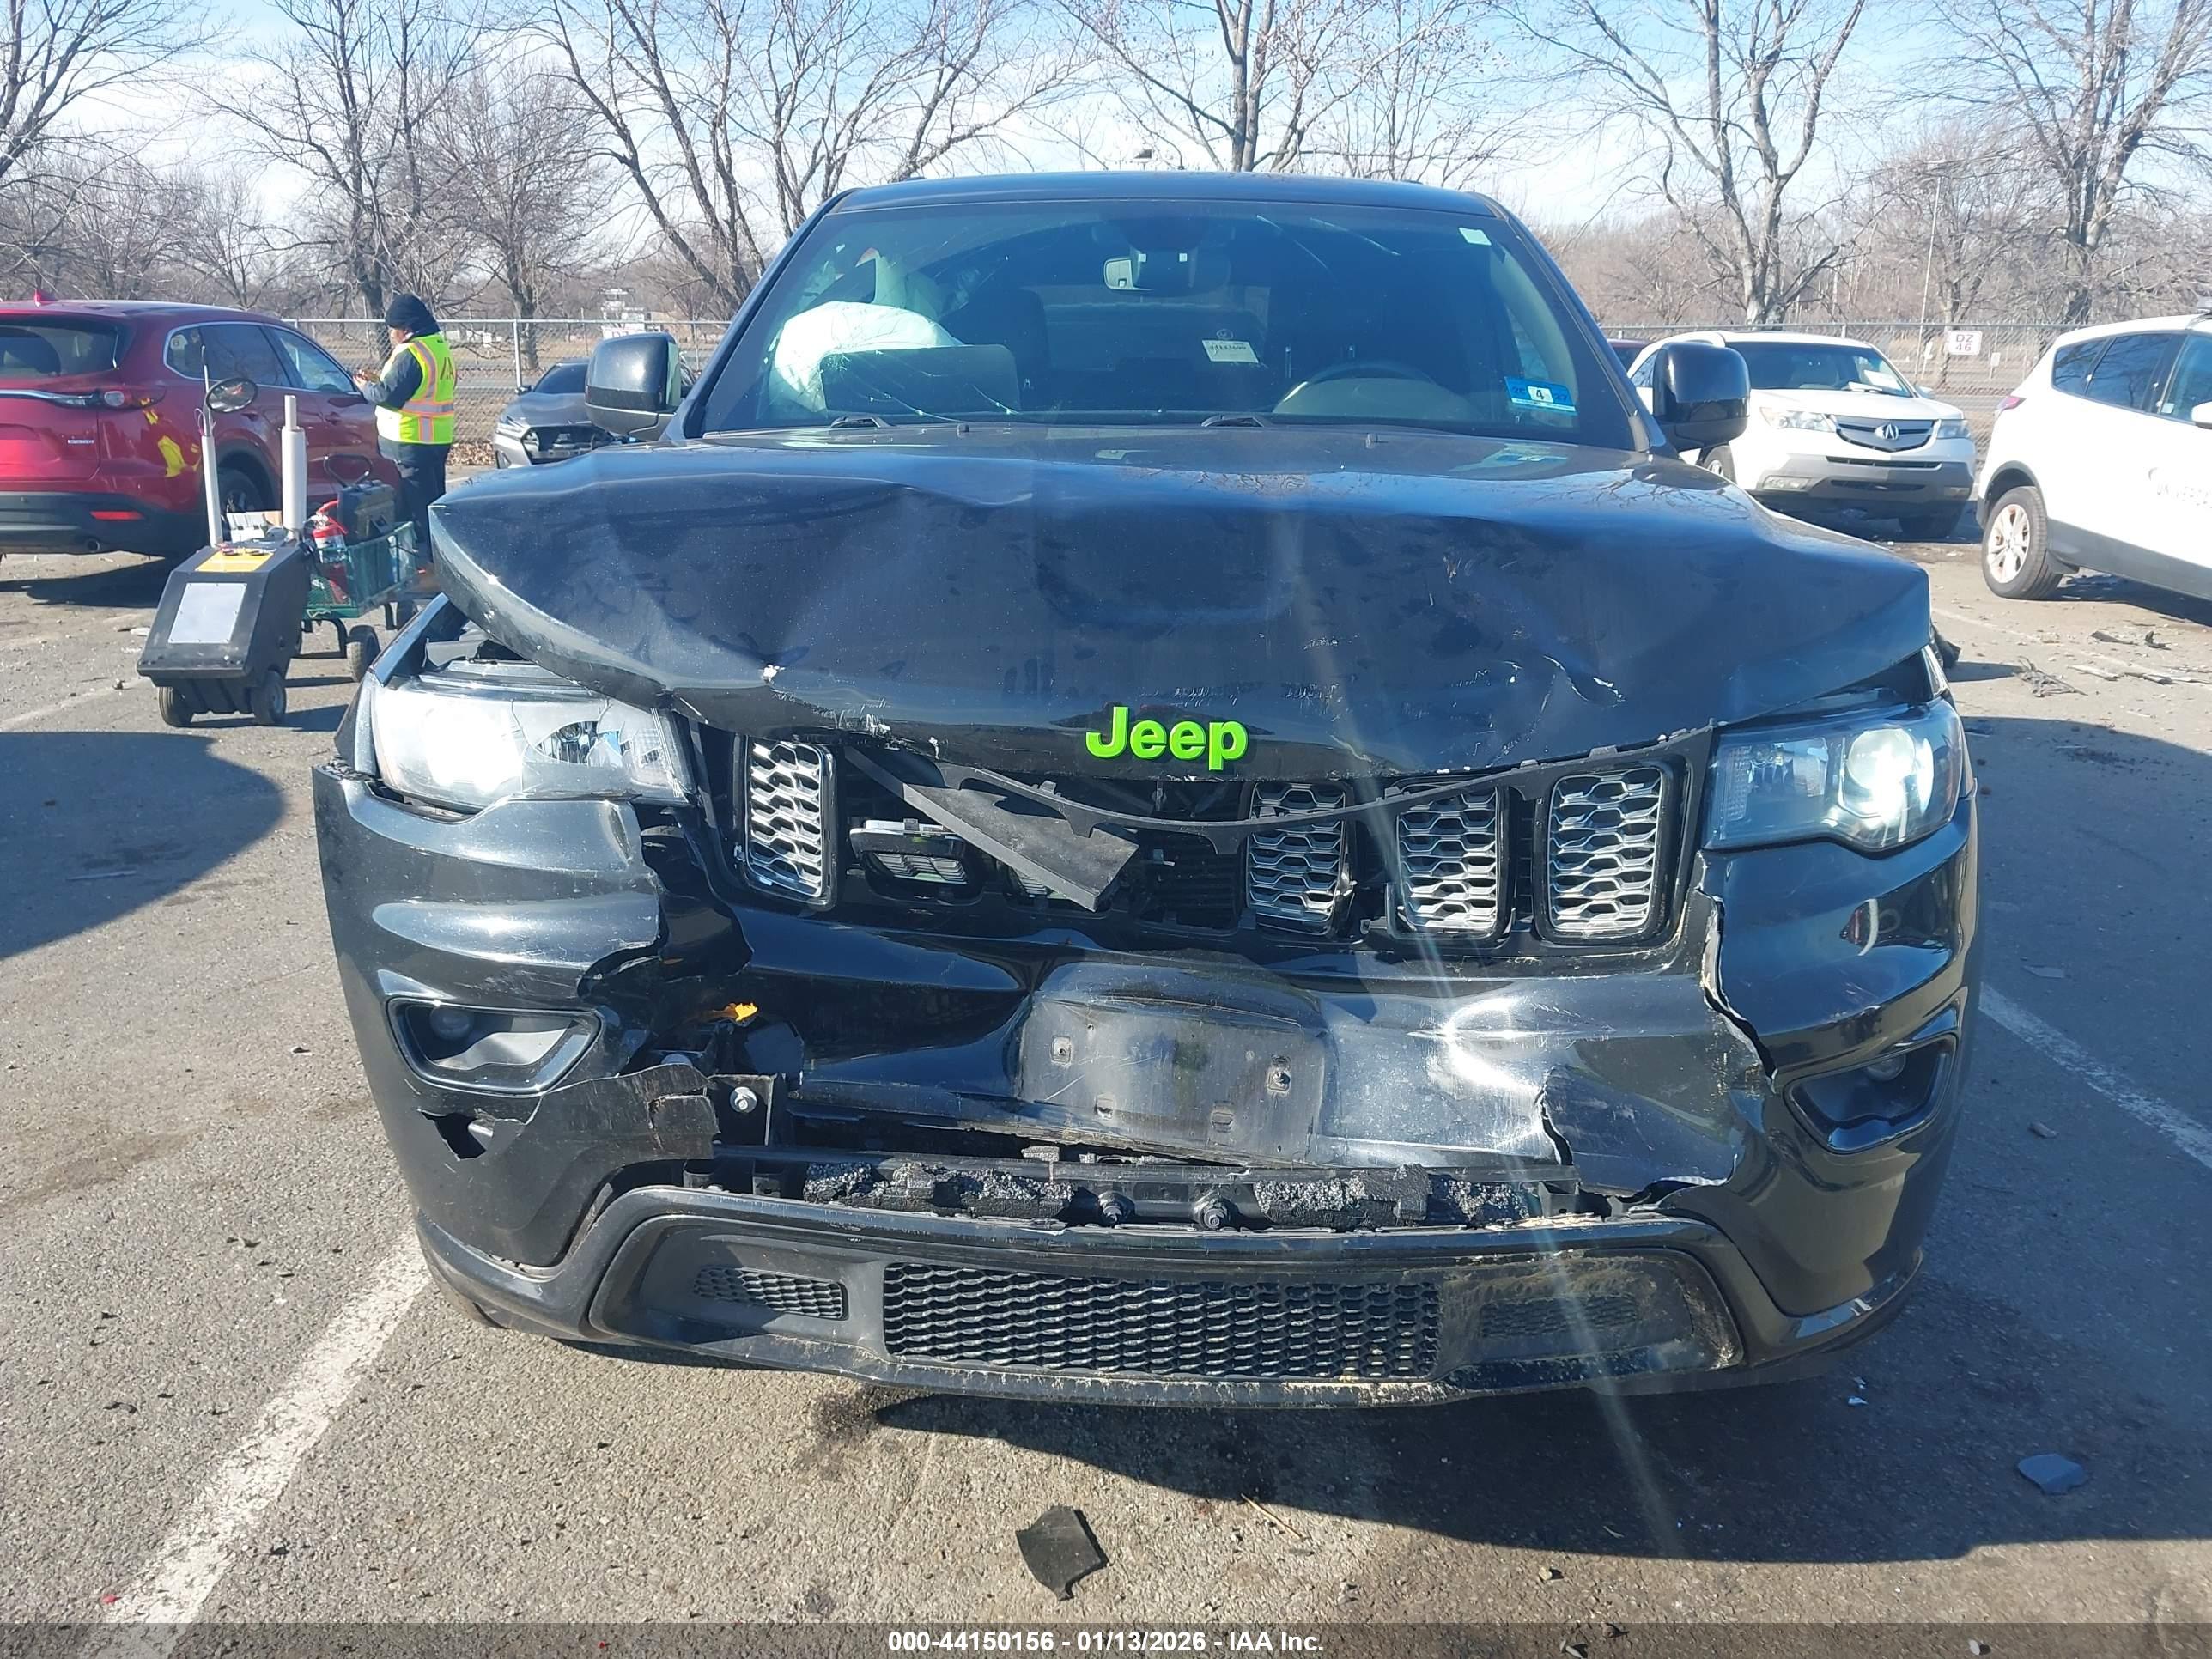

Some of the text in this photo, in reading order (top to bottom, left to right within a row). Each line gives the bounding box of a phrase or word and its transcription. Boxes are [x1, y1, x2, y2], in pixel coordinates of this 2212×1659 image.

[1956, 334, 1973, 343] DZ
[1536, 389, 1545, 400] 4
[1085, 706, 1248, 771] Jeep
